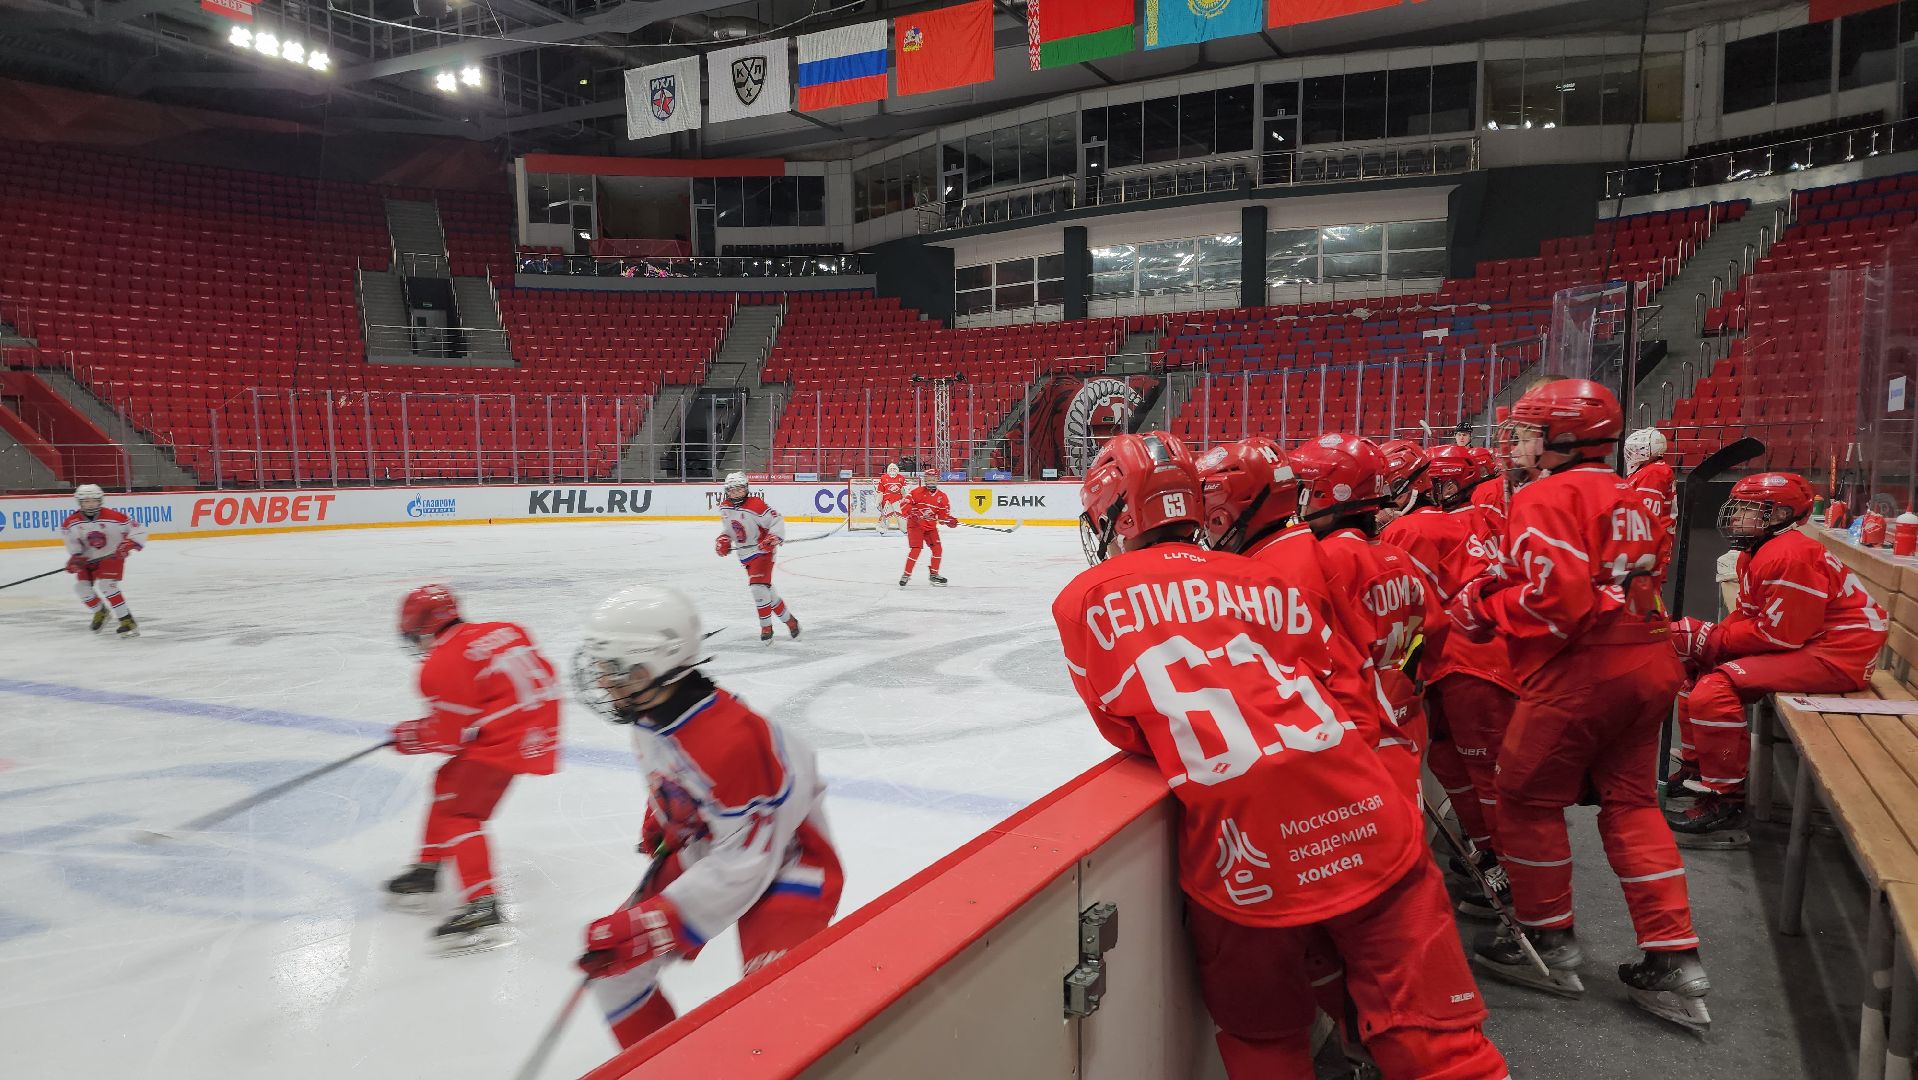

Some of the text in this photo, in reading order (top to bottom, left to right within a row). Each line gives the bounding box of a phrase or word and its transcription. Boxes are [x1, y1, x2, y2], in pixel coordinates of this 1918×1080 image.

[190, 494, 336, 527] FONBET
[528, 489, 653, 514] KHL.RU
[997, 495, 1047, 508] БАНК
[1163, 493, 1187, 517] 63
[1163, 552, 1207, 563] LUTCH
[1086, 578, 1313, 651] СЕЛИВАНОВ
[1135, 632, 1345, 786] 63
[1279, 794, 1384, 840] Московская
[1288, 822, 1379, 863] академия
[1296, 853, 1364, 886] хоккея
